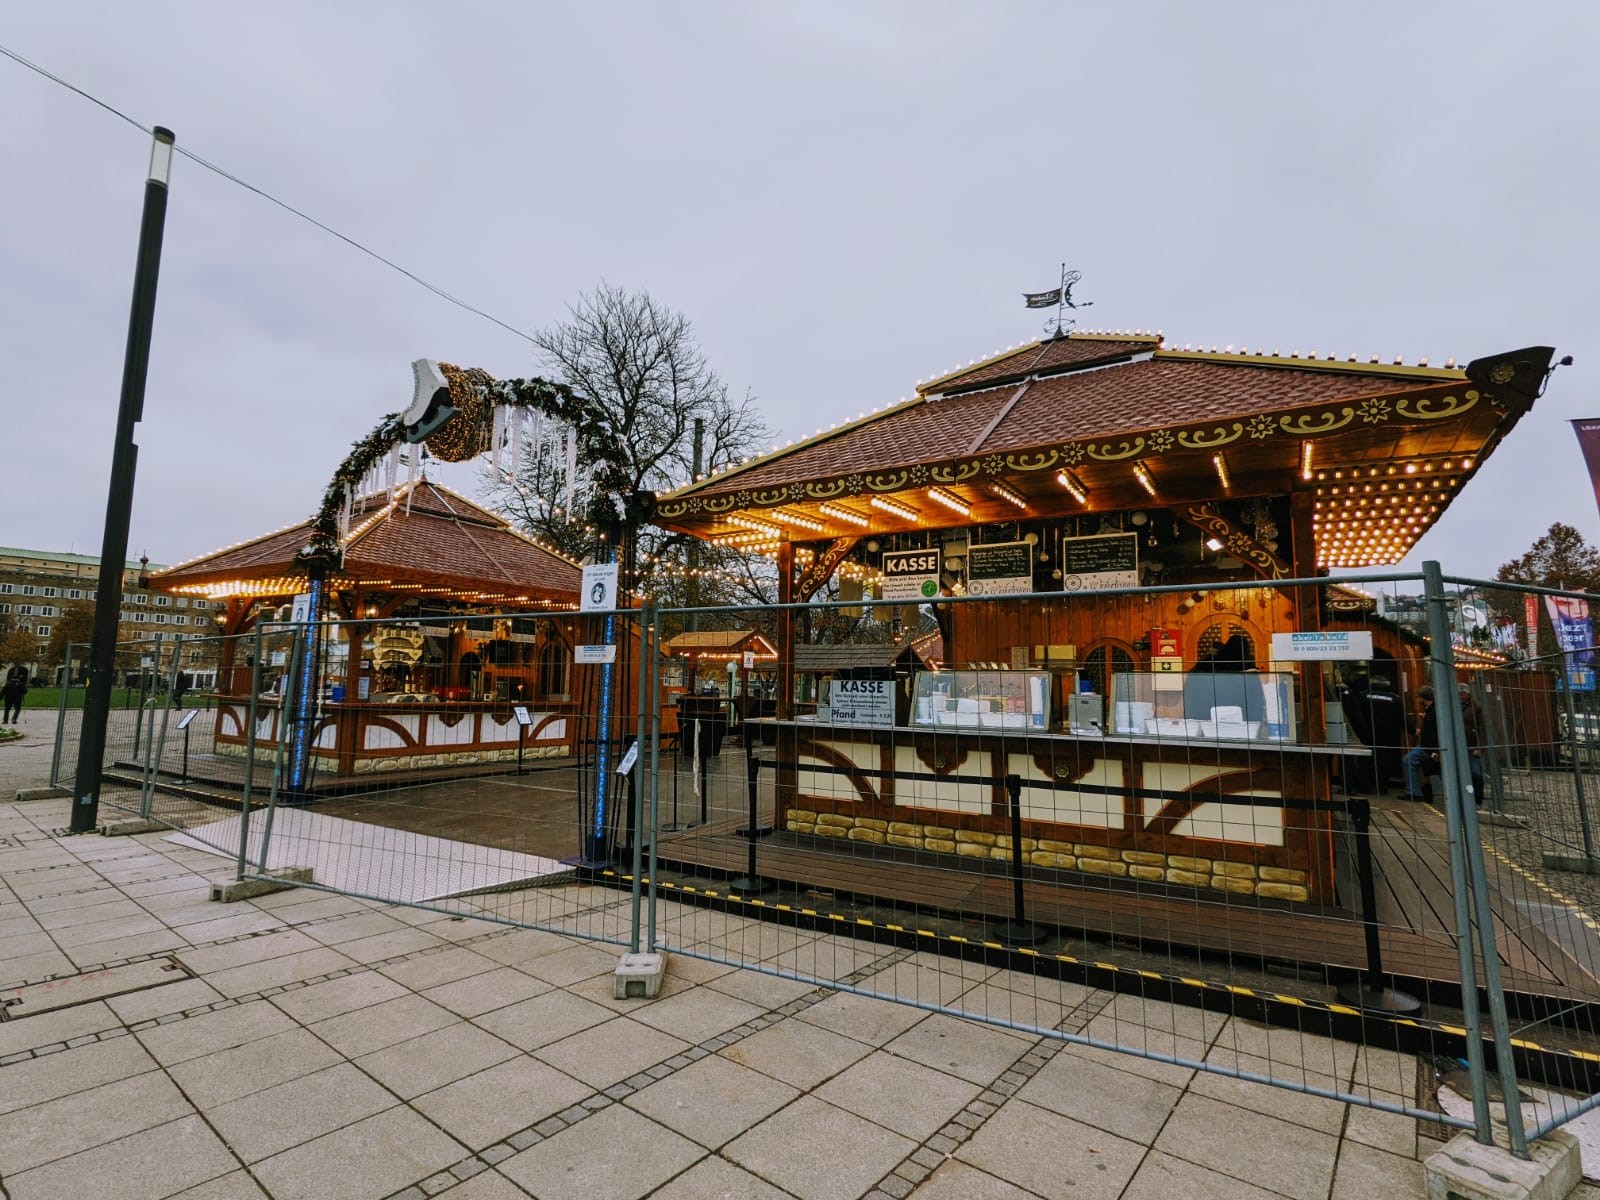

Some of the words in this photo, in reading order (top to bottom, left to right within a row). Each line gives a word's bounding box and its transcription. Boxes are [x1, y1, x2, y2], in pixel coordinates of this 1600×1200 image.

[887, 556, 936, 572] KASSE
[840, 681, 883, 693] KASSE
[831, 709, 856, 719] Pfand
